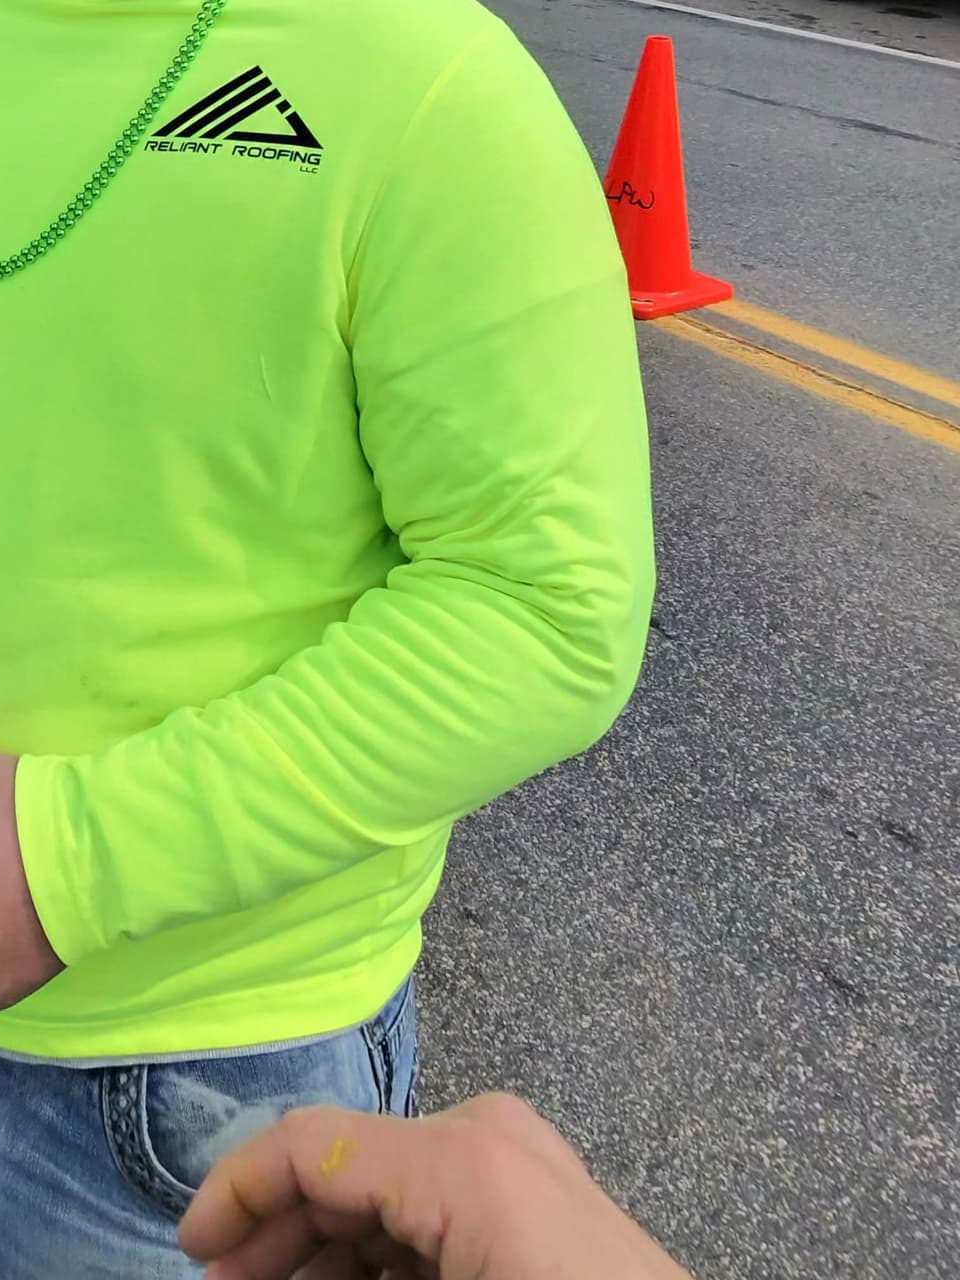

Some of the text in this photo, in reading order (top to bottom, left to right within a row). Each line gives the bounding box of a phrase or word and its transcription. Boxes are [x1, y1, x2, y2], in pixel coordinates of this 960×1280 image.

[144, 140, 322, 166] RELIANT ROOFING
[299, 166, 319, 174] LLC
